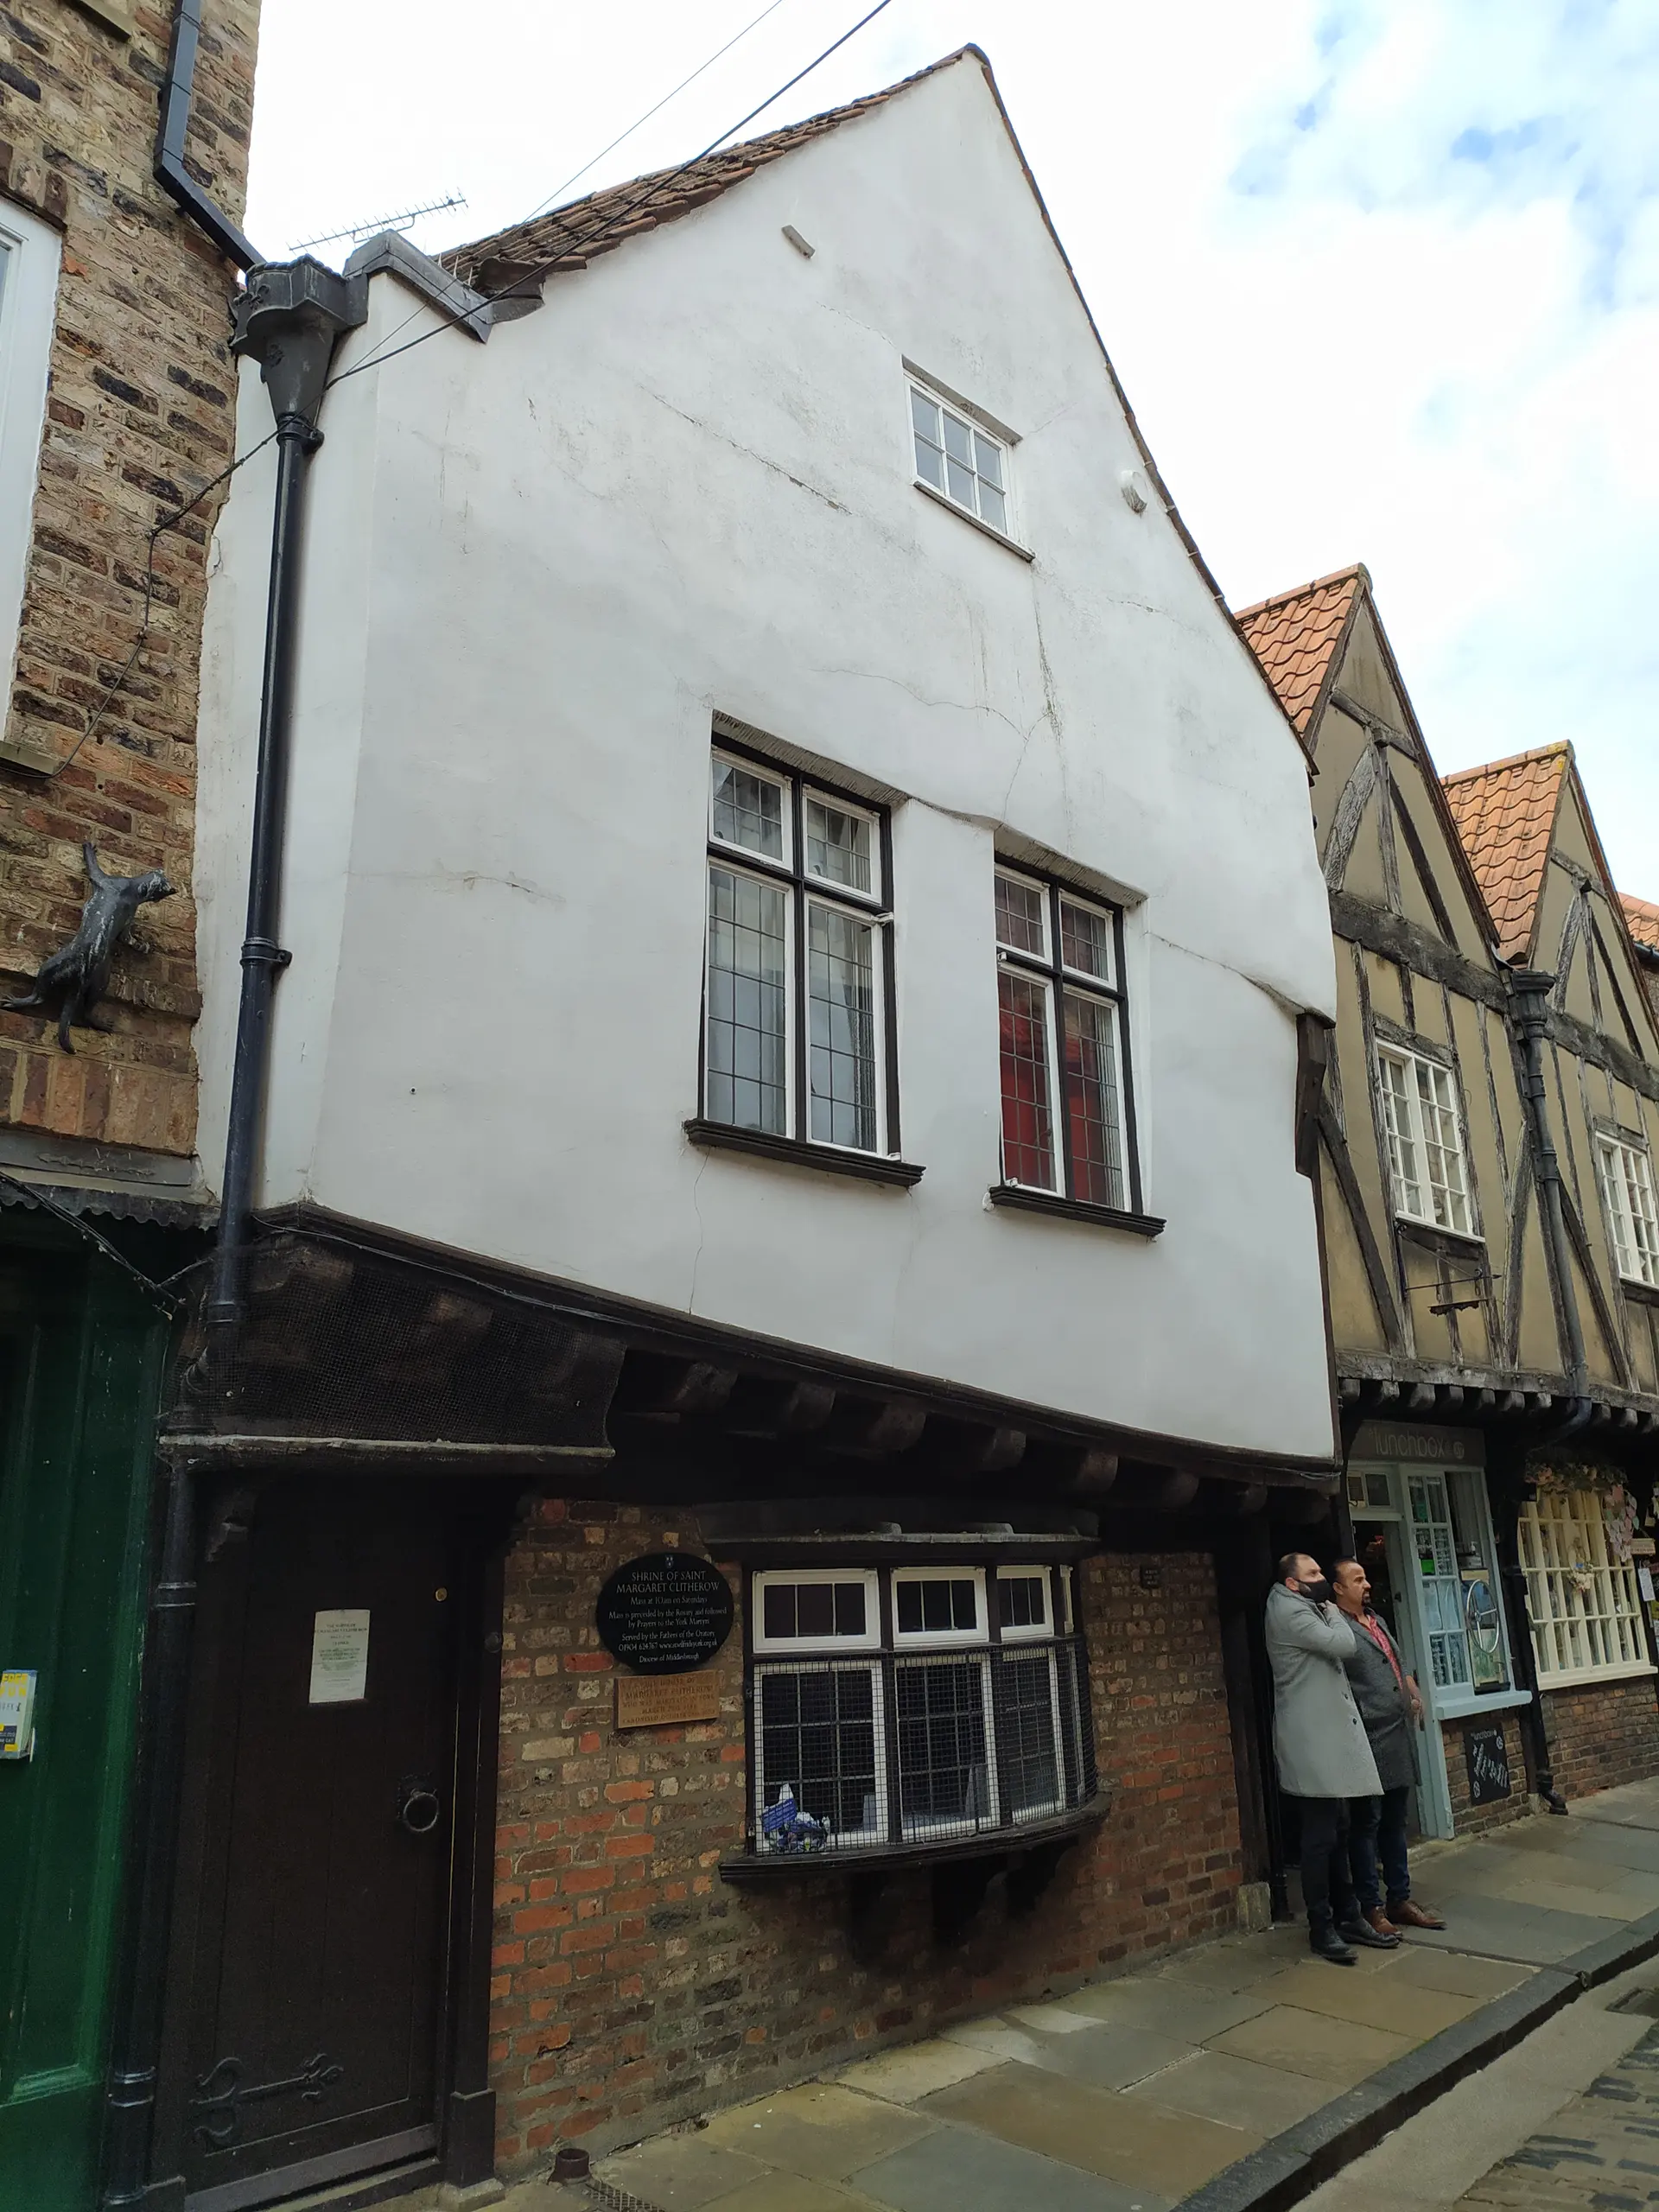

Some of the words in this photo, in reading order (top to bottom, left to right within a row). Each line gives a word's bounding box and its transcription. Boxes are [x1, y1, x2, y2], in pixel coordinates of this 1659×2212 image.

[1374, 1427, 1446, 1459] lunchbox
[632, 1571, 664, 1581] SHRINE
[666, 1571, 678, 1580] OF
[681, 1570, 706, 1580] SAINT
[616, 1582, 667, 1593] MARGARET
[669, 1580, 720, 1592] CLITHEROW
[631, 1610, 657, 1621] preceded
[657, 1609, 664, 1618] by
[665, 1609, 675, 1618] the
[676, 1608, 694, 1618] Rosary
[694, 1607, 704, 1616] and
[704, 1606, 728, 1616] followed
[627, 1619, 636, 1630] by
[637, 1619, 657, 1630] Prayers
[664, 1618, 674, 1627] the
[676, 1618, 688, 1626] York
[621, 1632, 640, 1642] Served
[641, 1632, 649, 1643] by
[649, 1631, 658, 1640] the
[659, 1630, 678, 1640] Fathers
[678, 1630, 685, 1639] of
[685, 1630, 695, 1638] the
[695, 1628, 715, 1638] Oratory
[618, 1643, 638, 1652] 01904
[665, 1651, 700, 1662] Middlesbrough
